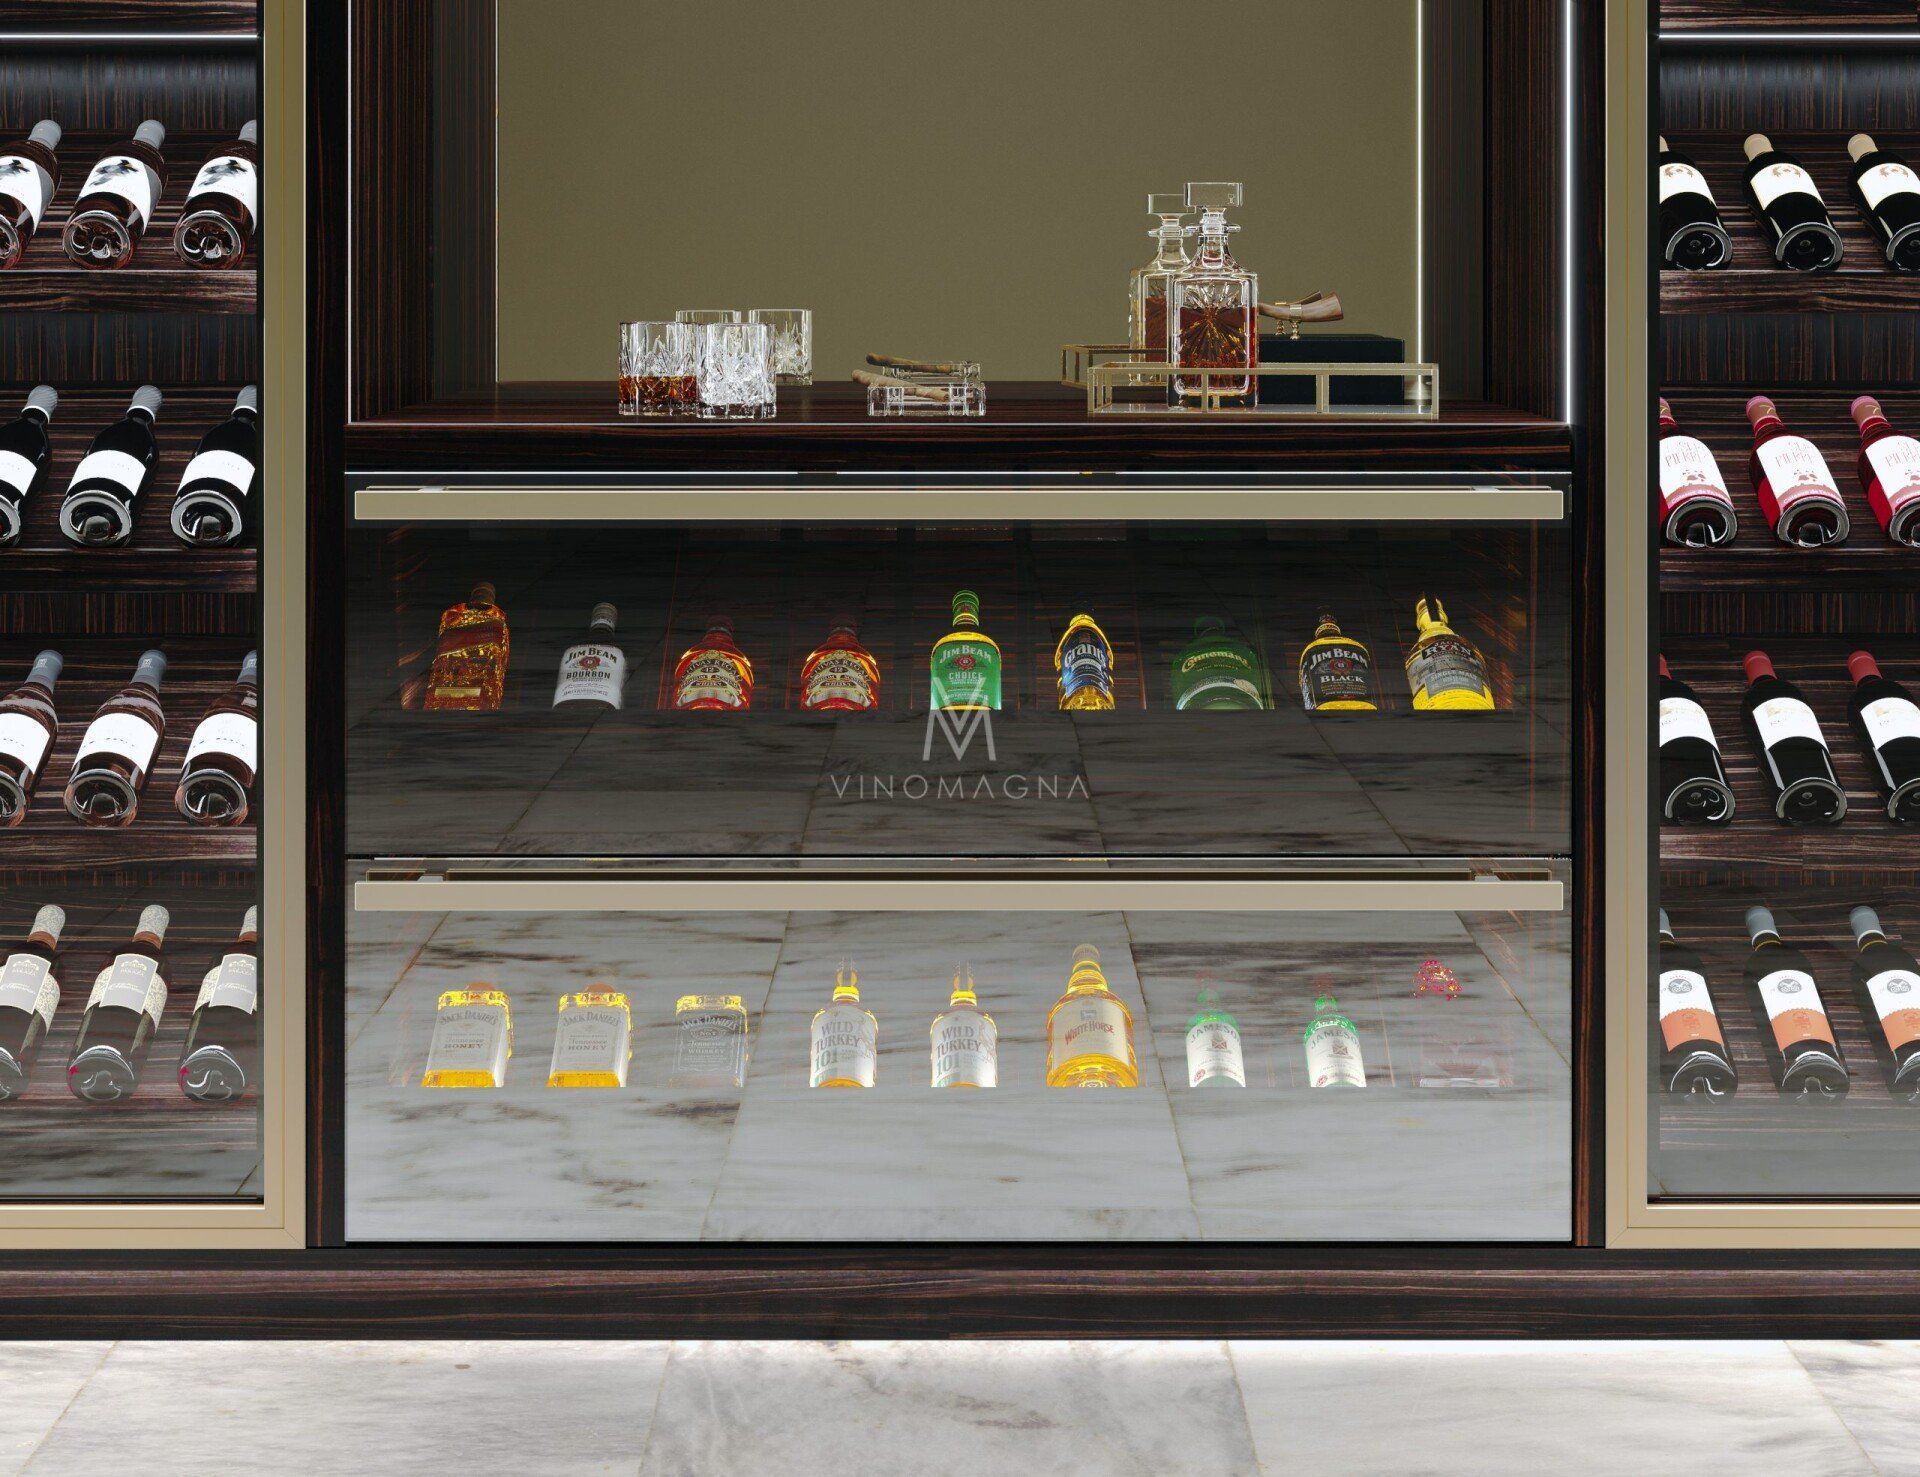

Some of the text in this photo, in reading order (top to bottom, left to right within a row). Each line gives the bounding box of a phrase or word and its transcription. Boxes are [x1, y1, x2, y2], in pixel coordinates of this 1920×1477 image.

[565, 648, 617, 664] JIM BEAM
[940, 645, 991, 663] JIM BEAM
[1310, 648, 1368, 670] JIM BEAM
[566, 670, 611, 680] BOURBON
[949, 671, 983, 681] CHOICE
[1320, 675, 1364, 683] BLACK
[821, 1021, 854, 1036] WILD
[942, 1026, 975, 1040] WILD
[815, 1033, 861, 1054] TURKEY
[936, 1038, 981, 1060] TURKEY
[815, 1050, 838, 1070] 101
[936, 1052, 960, 1076] 101
